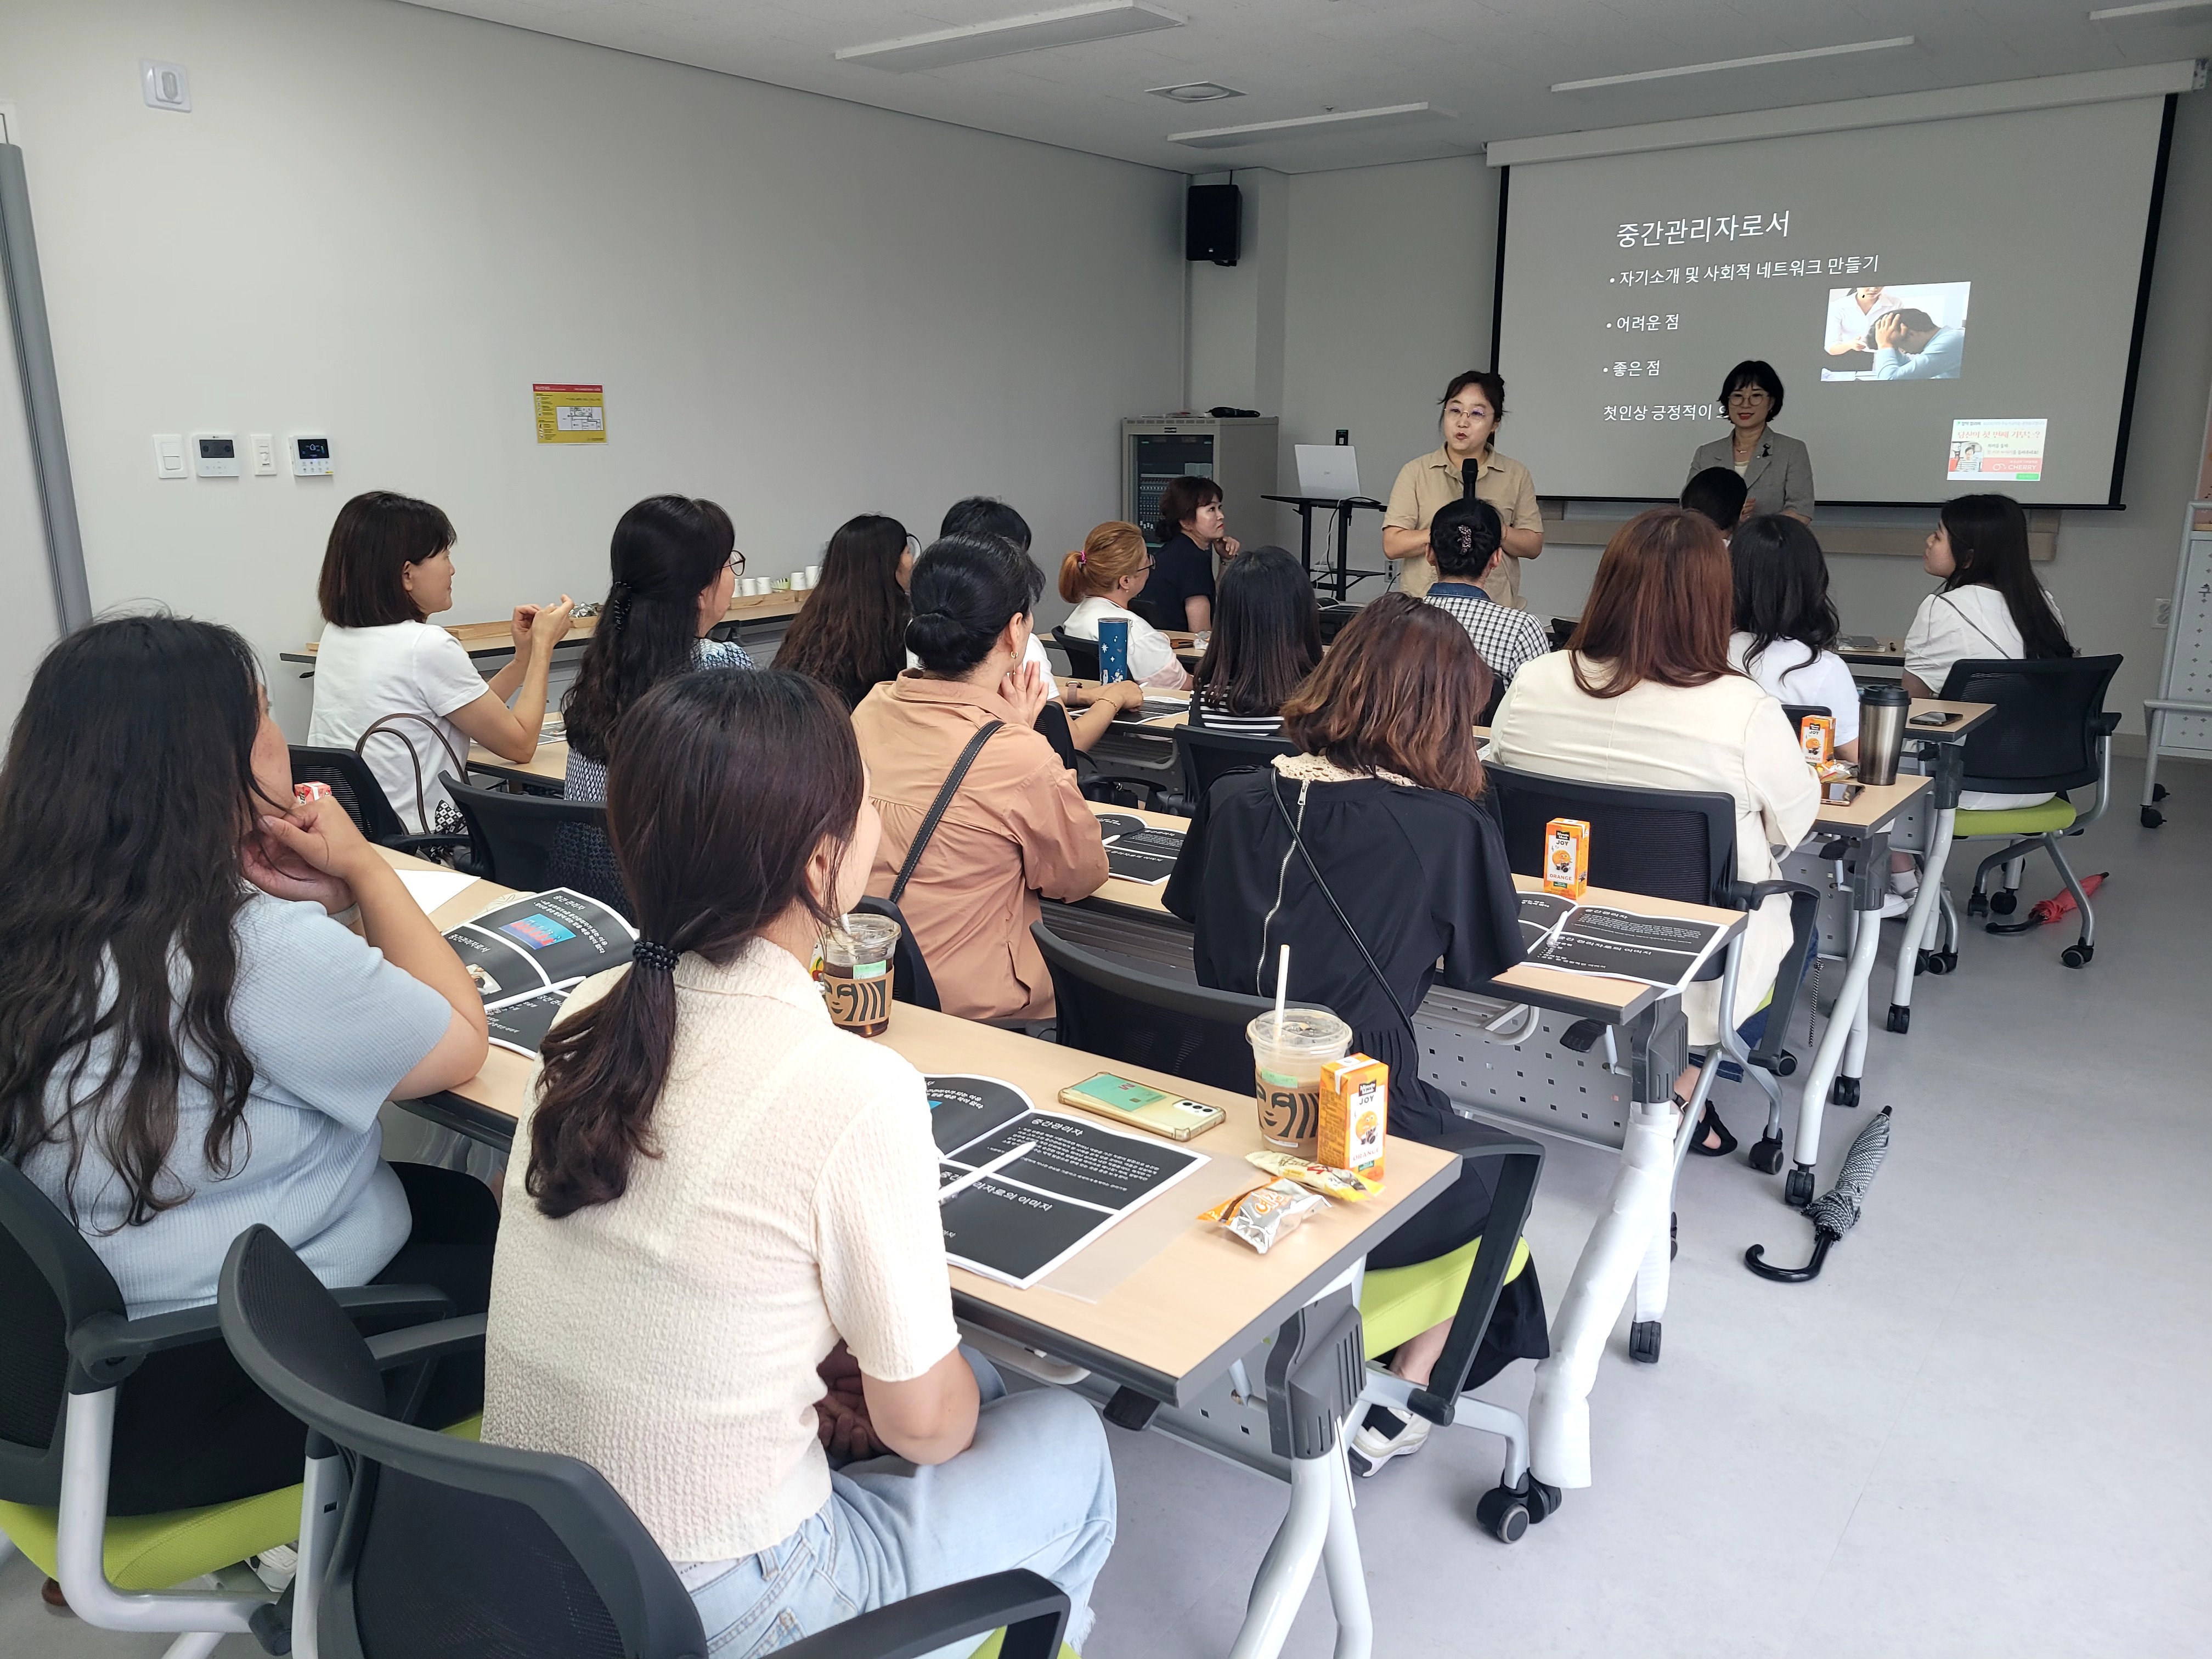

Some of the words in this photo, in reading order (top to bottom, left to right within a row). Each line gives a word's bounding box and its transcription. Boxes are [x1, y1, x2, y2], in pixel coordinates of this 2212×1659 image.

[1616, 210, 1790, 248] 중간관리자로서
[1619, 267, 1680, 287] 자기소개
[1685, 267, 1700, 284] 및
[1703, 263, 1751, 281] 사회적
[1757, 258, 1822, 278] 네트워크
[1827, 255, 1879, 274] 만들기
[1617, 315, 1661, 332] 어려운
[1665, 313, 1679, 330] 점
[1612, 361, 1643, 377] 좋은
[1646, 360, 1660, 376] 점
[1604, 405, 1648, 421] 첫인상
[1651, 404, 1712, 421] 긍정적이
[565, 900, 586, 910] 관리자
[448, 934, 491, 953] 중간관리자로서
[595, 944, 606, 953] 없다
[598, 936, 608, 946] 이유
[1624, 947, 1652, 956] 이미지
[1359, 1094, 1374, 1105] JOY
[1031, 1118, 1084, 1137] 중간관리자
[1353, 1147, 1380, 1161] ORANGE
[1018, 1196, 1053, 1211] 이미지
